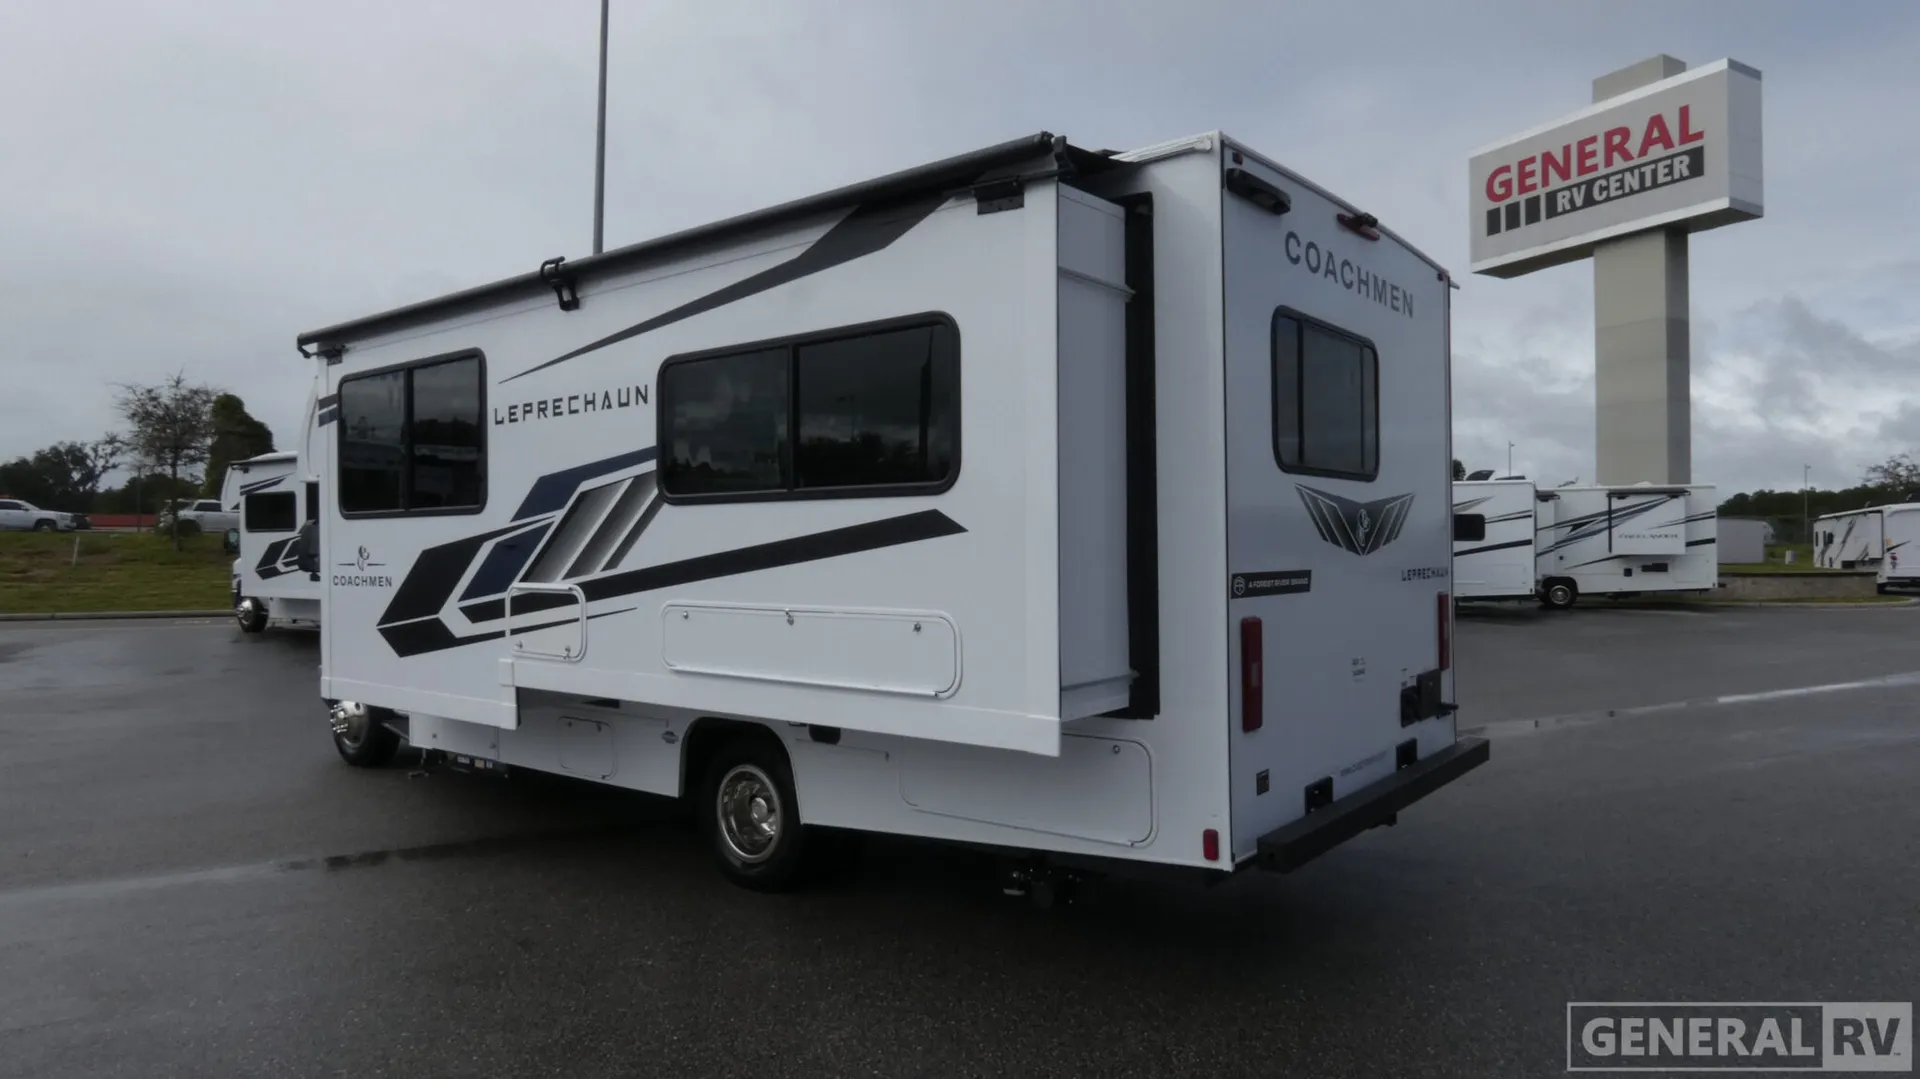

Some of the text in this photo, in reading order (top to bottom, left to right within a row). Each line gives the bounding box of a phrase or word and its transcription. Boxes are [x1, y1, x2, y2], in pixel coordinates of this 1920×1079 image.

[1485, 104, 1704, 203] GENERAL
[1556, 154, 1690, 213] RV CENTER
[1284, 231, 1414, 319] COACHMEN
[494, 384, 649, 426] LEPRECHAUN
[332, 574, 393, 588] COACHMEN
